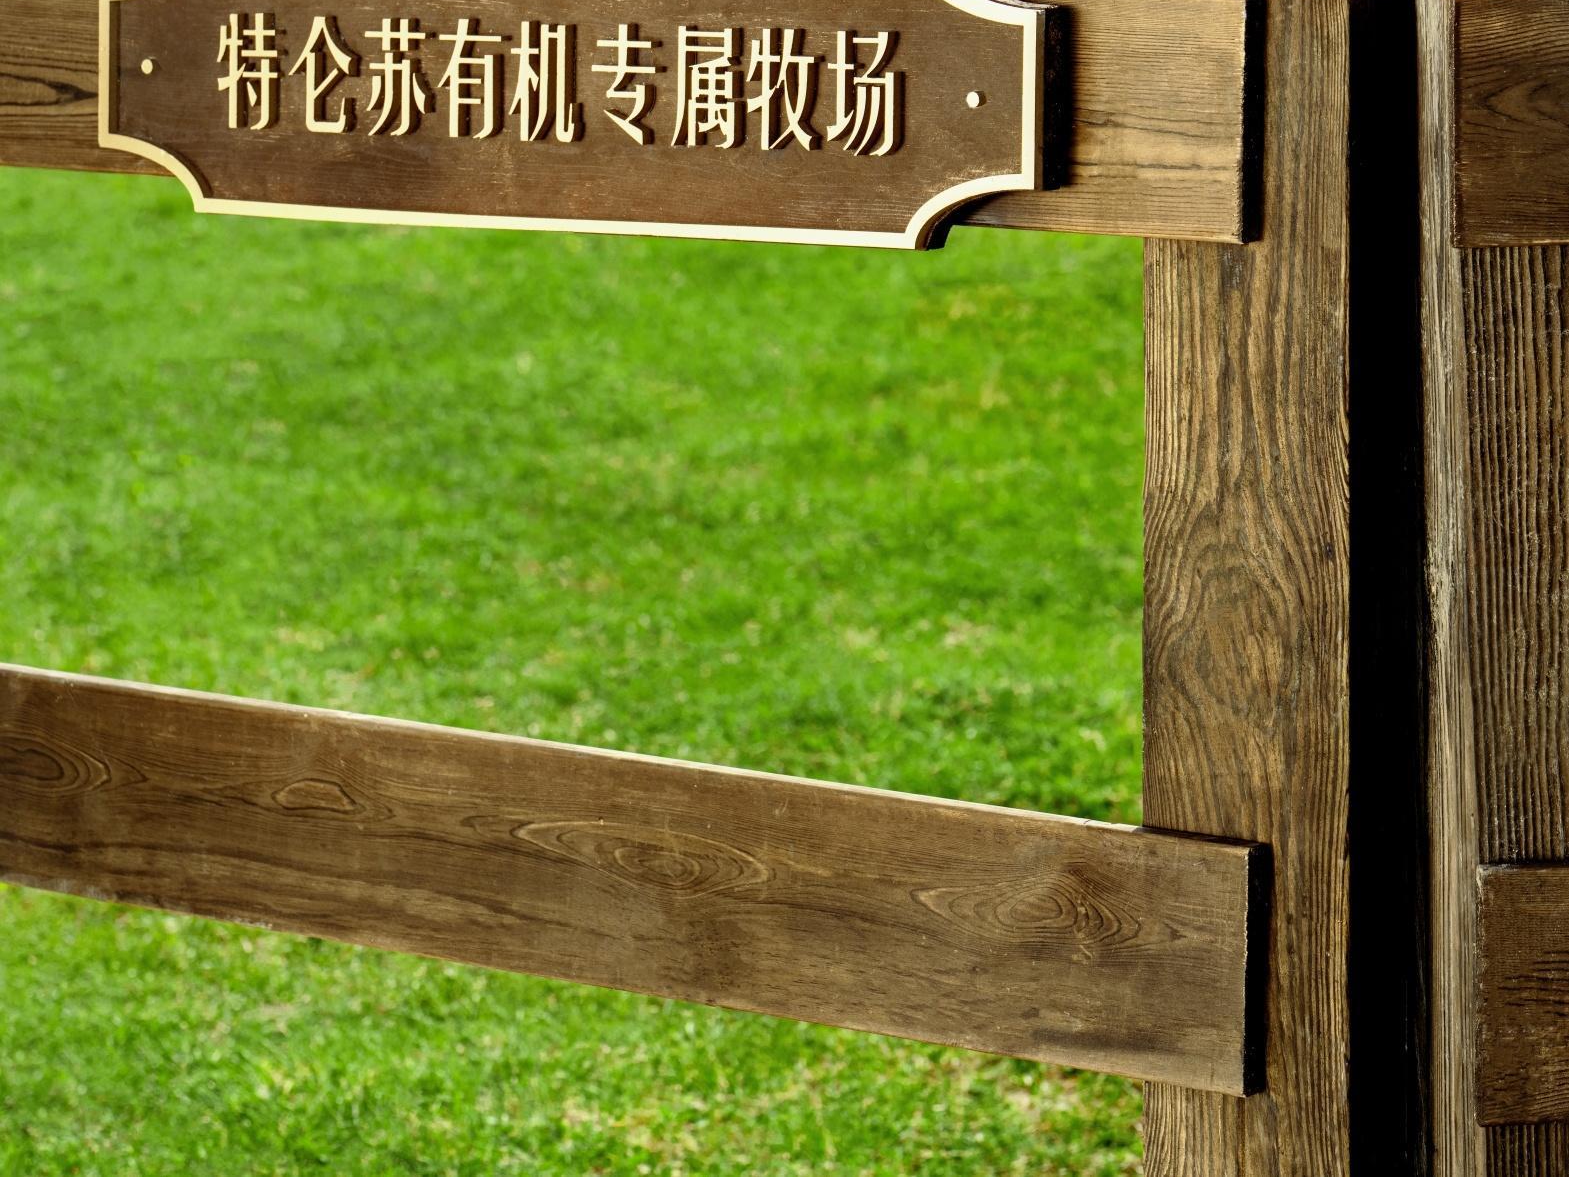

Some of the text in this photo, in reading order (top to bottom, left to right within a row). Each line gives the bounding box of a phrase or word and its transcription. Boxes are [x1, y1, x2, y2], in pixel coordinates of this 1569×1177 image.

[217, 13, 897, 156] 特仑苏有机专属牧场
